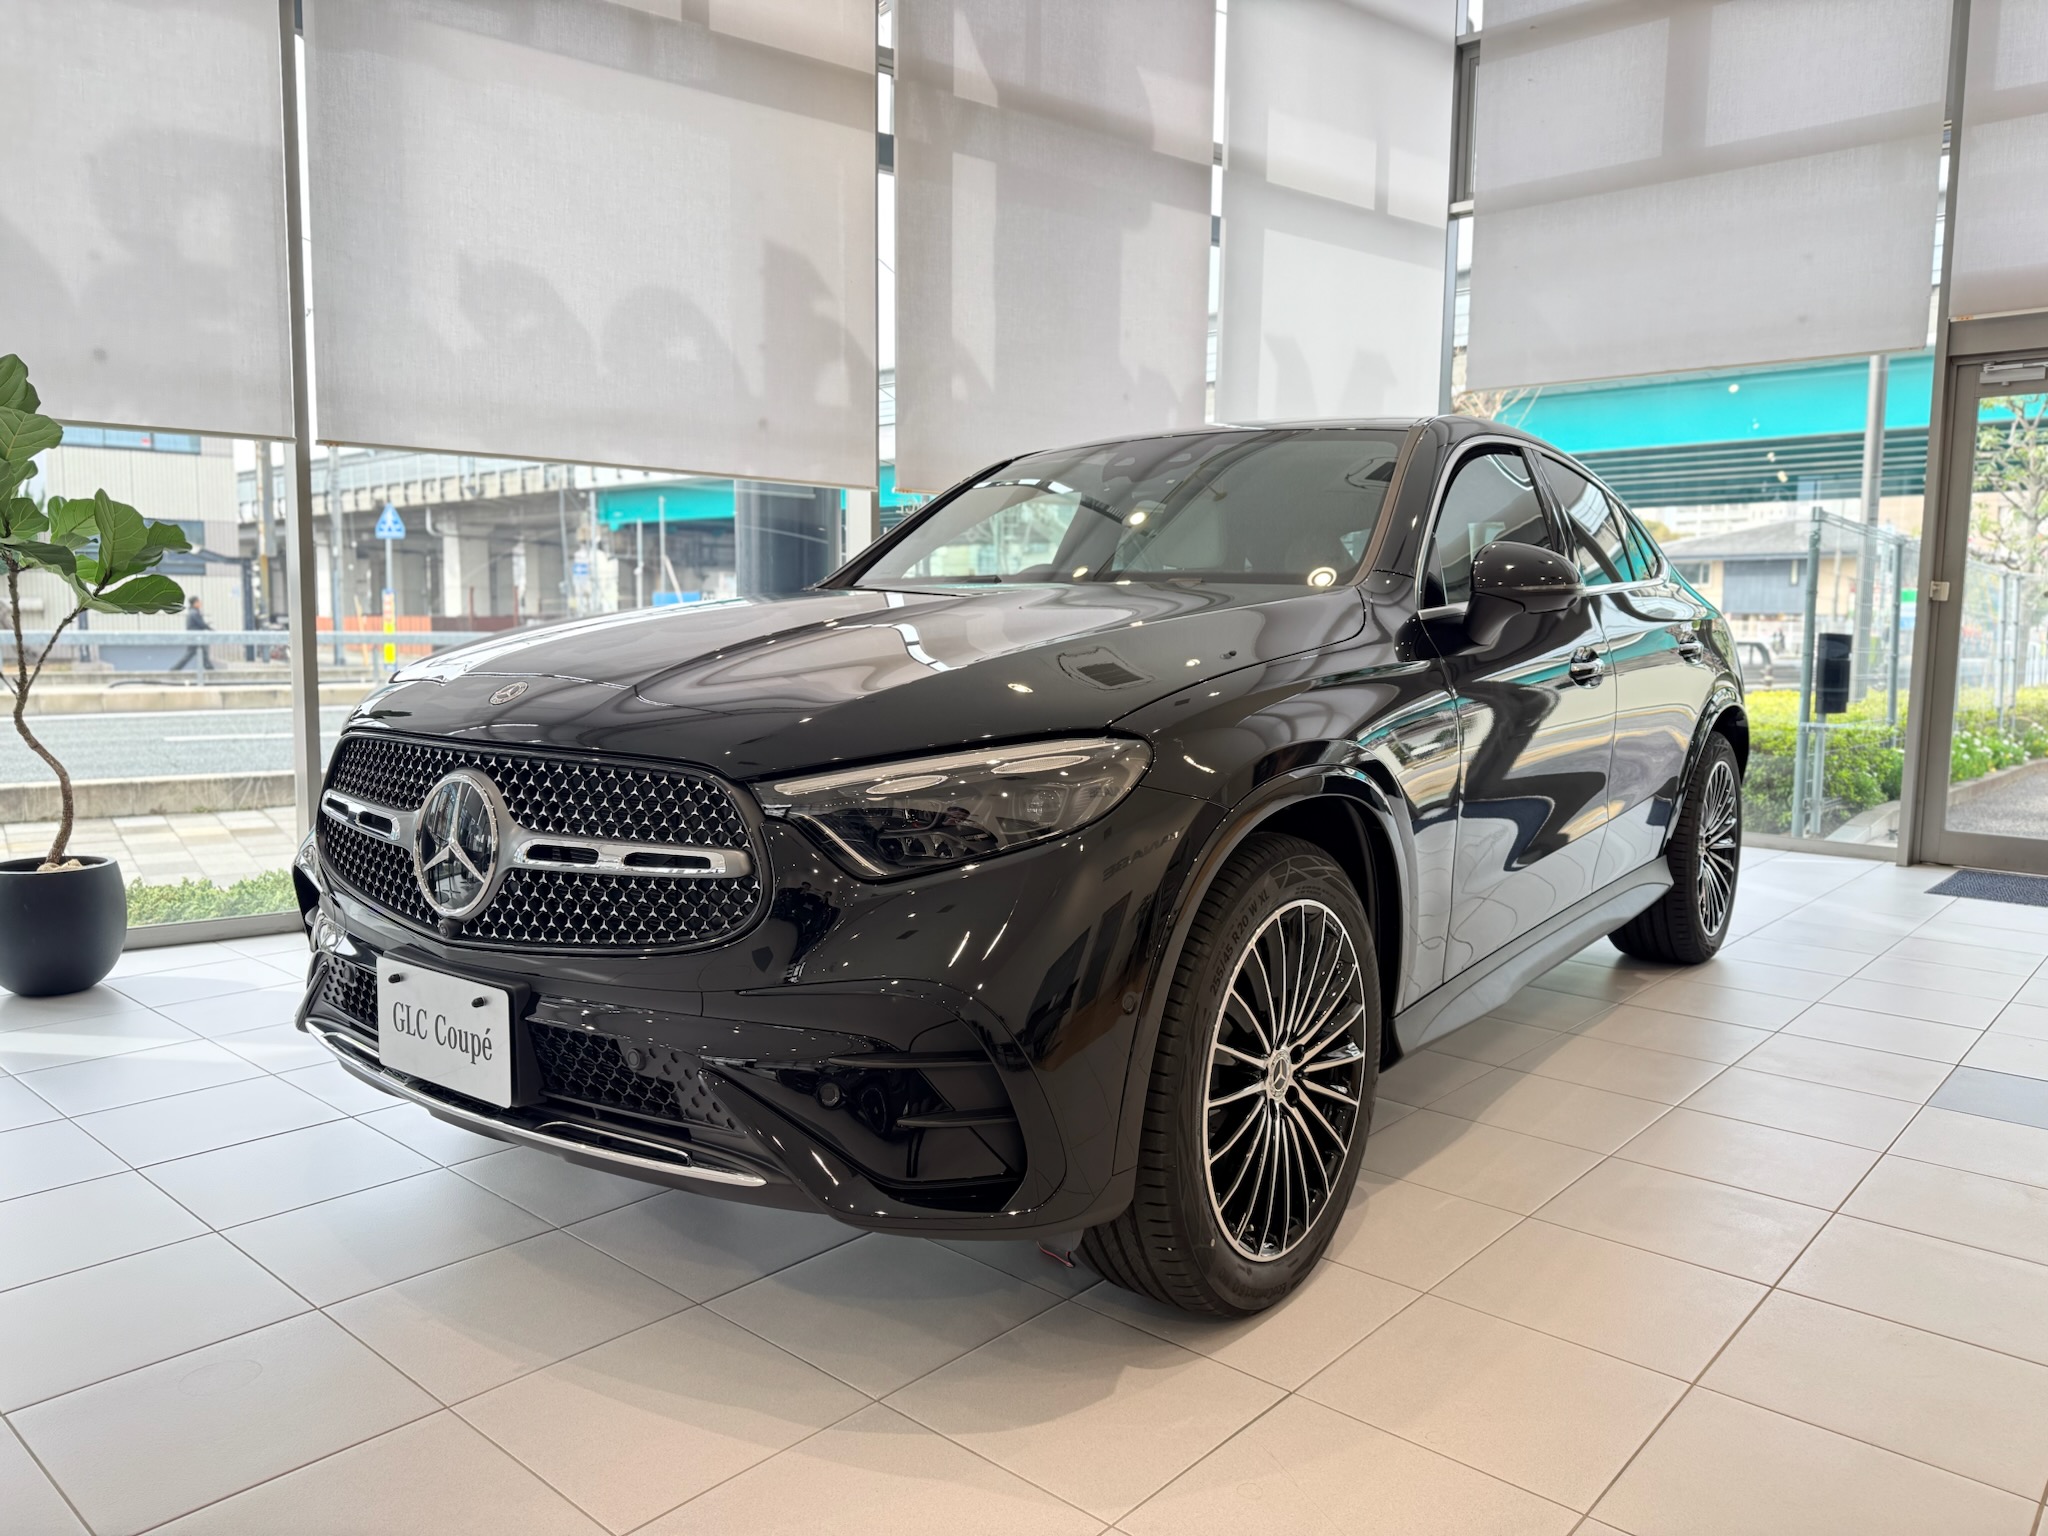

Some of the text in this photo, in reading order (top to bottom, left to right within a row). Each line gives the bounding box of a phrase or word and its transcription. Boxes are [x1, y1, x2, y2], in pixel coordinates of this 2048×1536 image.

[1210, 943, 1234, 997] 255/45
[1248, 900, 1258, 917] W
[1258, 889, 1270, 906] XL
[393, 1001, 493, 1065] GLC Coupé
